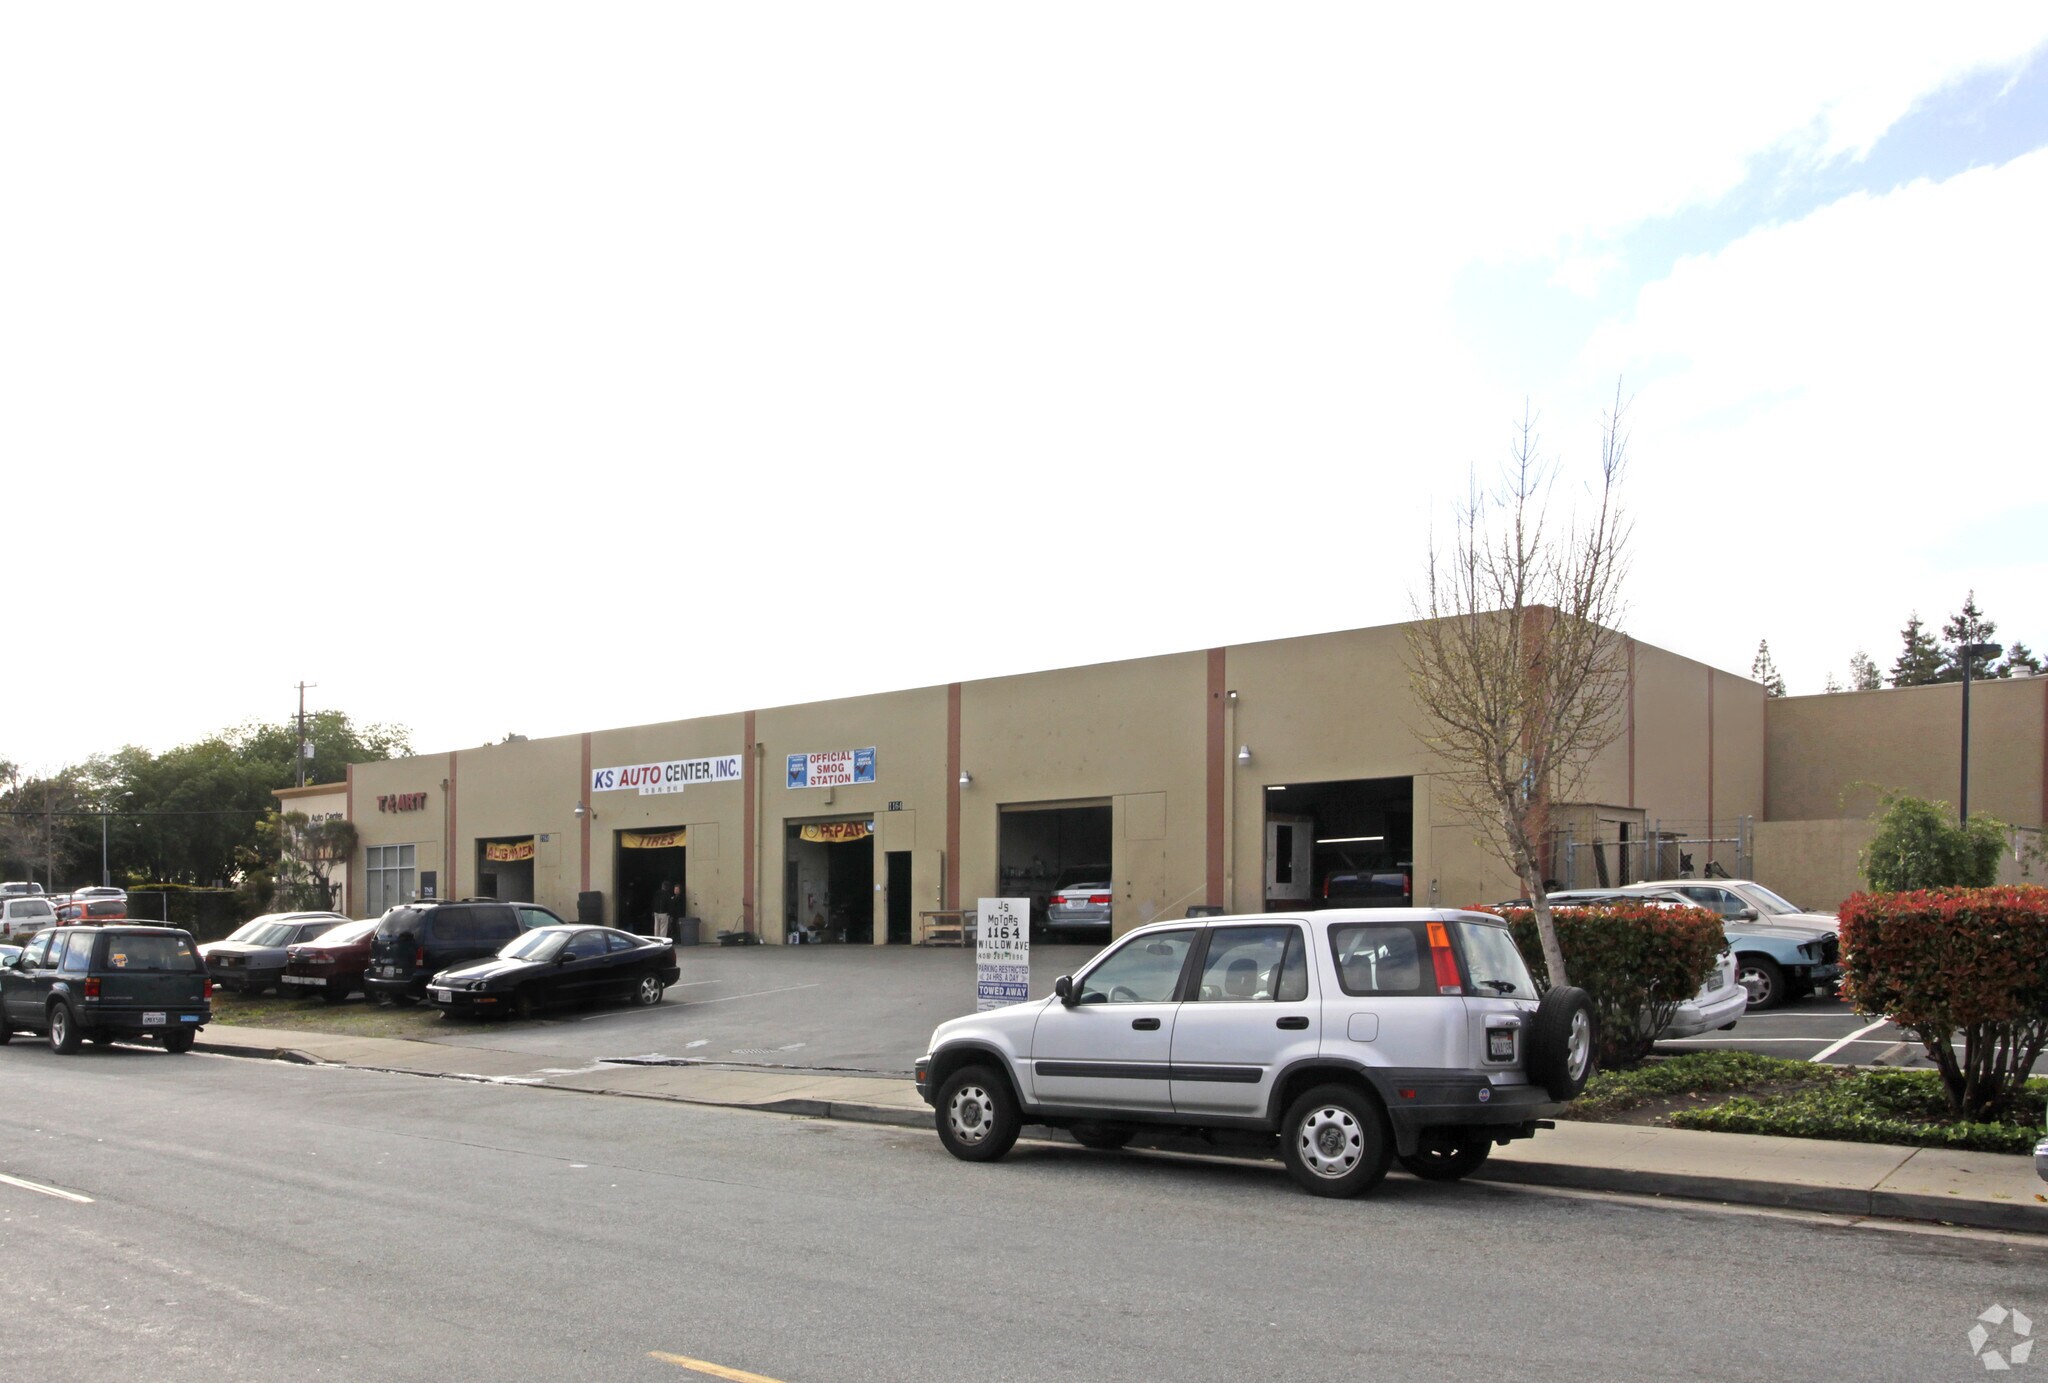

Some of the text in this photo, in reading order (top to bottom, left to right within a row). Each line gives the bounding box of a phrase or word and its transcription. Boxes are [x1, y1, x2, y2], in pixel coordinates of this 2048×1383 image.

[810, 751, 852, 764] OFFICIAL
[594, 758, 740, 789] KS AUTO CENTER, INC.
[816, 763, 845, 774] SMOG
[810, 774, 851, 786] STATION
[397, 792, 427, 811] ART
[311, 811, 344, 822] Auto Center
[639, 832, 677, 847] TIRES
[988, 914, 1018, 926] MOTORS
[988, 926, 1020, 939] 1164
[978, 940, 1030, 950] WILLOW AVE
[978, 964, 1029, 975] PARKING RESTRICTED
[1004, 974, 1009, 982] A
[1009, 974, 1019, 982] DAY
[979, 986, 1027, 997] TOWED AWAY
